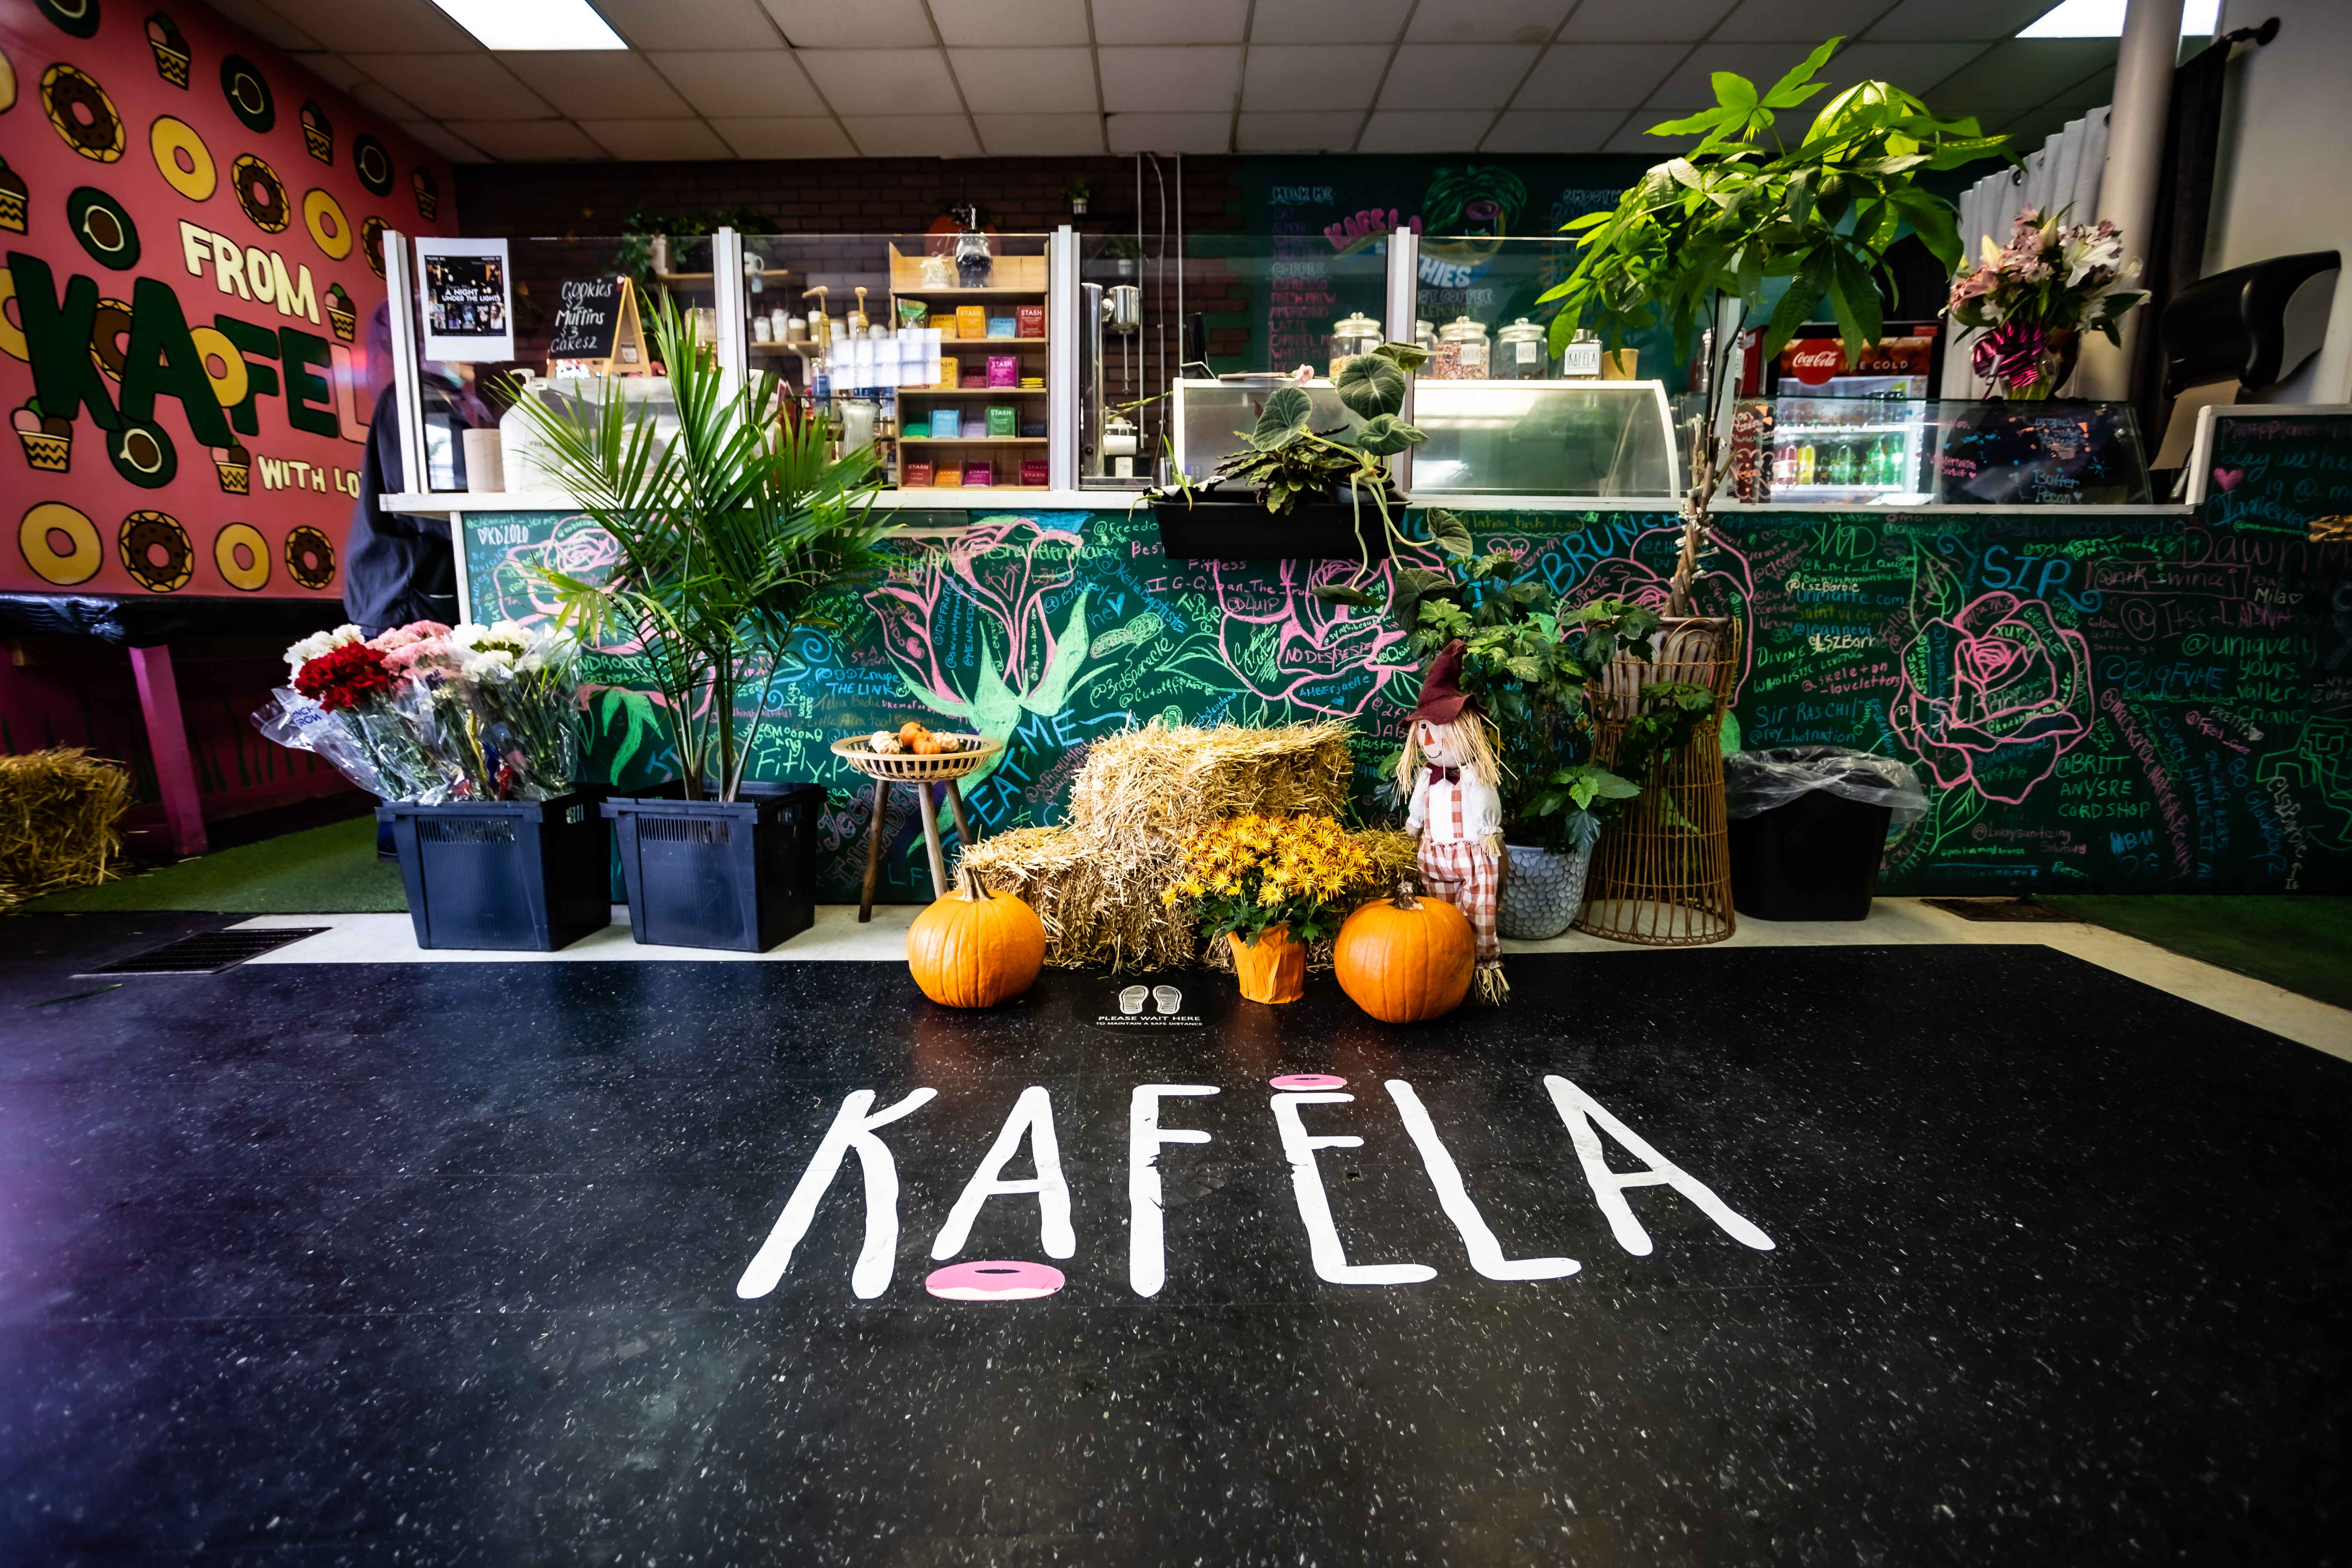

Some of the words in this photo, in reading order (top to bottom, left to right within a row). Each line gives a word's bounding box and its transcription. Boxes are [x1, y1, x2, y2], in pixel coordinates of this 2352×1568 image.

[1274, 207, 1295, 220] OAT
[1271, 222, 1311, 234] ALMOND
[178, 218, 320, 325] FROM
[1272, 261, 1325, 278] COFFEE
[562, 279, 612, 300] Cookies
[1272, 278, 1328, 291] ESPRESSO
[1271, 292, 1303, 304] FRESH
[1305, 292, 1336, 304] BREW
[1440, 288, 1493, 303] COFFEE
[555, 309, 605, 327] Muffins
[1271, 306, 1329, 318] AMERICANO
[1271, 320, 1308, 332] LATTE
[1271, 334, 1317, 347] CARAMEL
[1271, 347, 1309, 359] WHITE
[1873, 360, 1908, 370] COLD
[258, 455, 326, 493] WITH
[334, 467, 362, 499] LO
[2032, 485, 2071, 505] Pecan
[1541, 514, 1681, 596] BRUNCH
[2182, 526, 2307, 573] Dawn
[1981, 545, 2071, 599] SIP
[2254, 587, 2286, 604] Mila
[1755, 645, 1806, 668] DIVINE
[2182, 632, 2318, 667] @uniquely
[826, 683, 854, 695] THE
[858, 684, 897, 698] LINK
[1755, 704, 1788, 728] Sir
[968, 747, 1031, 827] EAT
[1015, 708, 1085, 756] ME
[2055, 753, 2131, 778] @BRITT
[2060, 777, 2132, 799] ANYSRE
